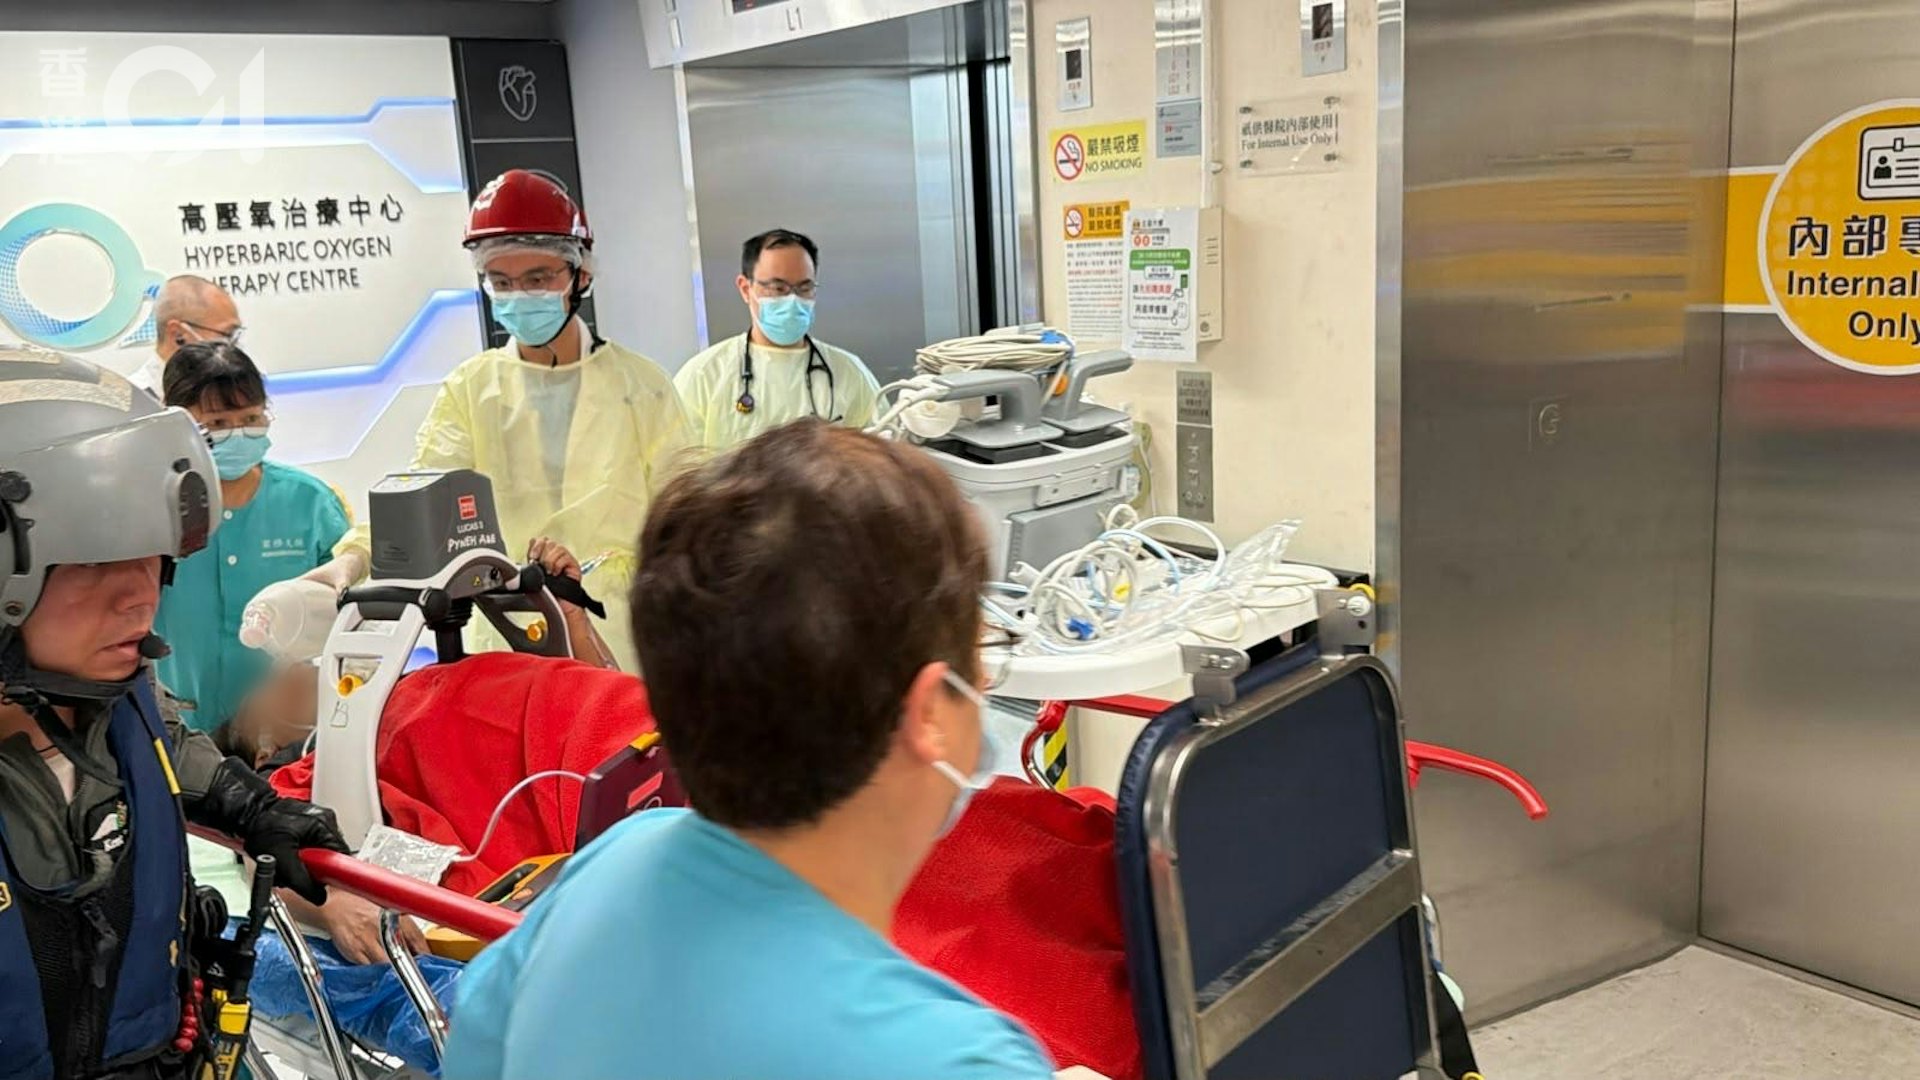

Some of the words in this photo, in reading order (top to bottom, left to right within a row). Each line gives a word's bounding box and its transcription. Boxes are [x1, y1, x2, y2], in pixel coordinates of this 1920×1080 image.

[786, 7, 803, 31] L1
[1242, 139, 1256, 151] For
[1258, 135, 1290, 149] Internal
[1292, 134, 1309, 145] Use
[1310, 132, 1332, 146] Only
[1085, 161, 1099, 173] NO
[1101, 158, 1142, 171] SMOKING
[178, 193, 403, 234] 高壓氧治療中心
[184, 240, 309, 269] HYPERBARIC
[313, 236, 392, 259] OXYGEN
[207, 271, 281, 296] ERAPY
[287, 267, 360, 292] CENTRE
[1787, 270, 1918, 297] Internal
[457, 522, 479, 534] LUCAS
[447, 536, 477, 553] PYNEH
